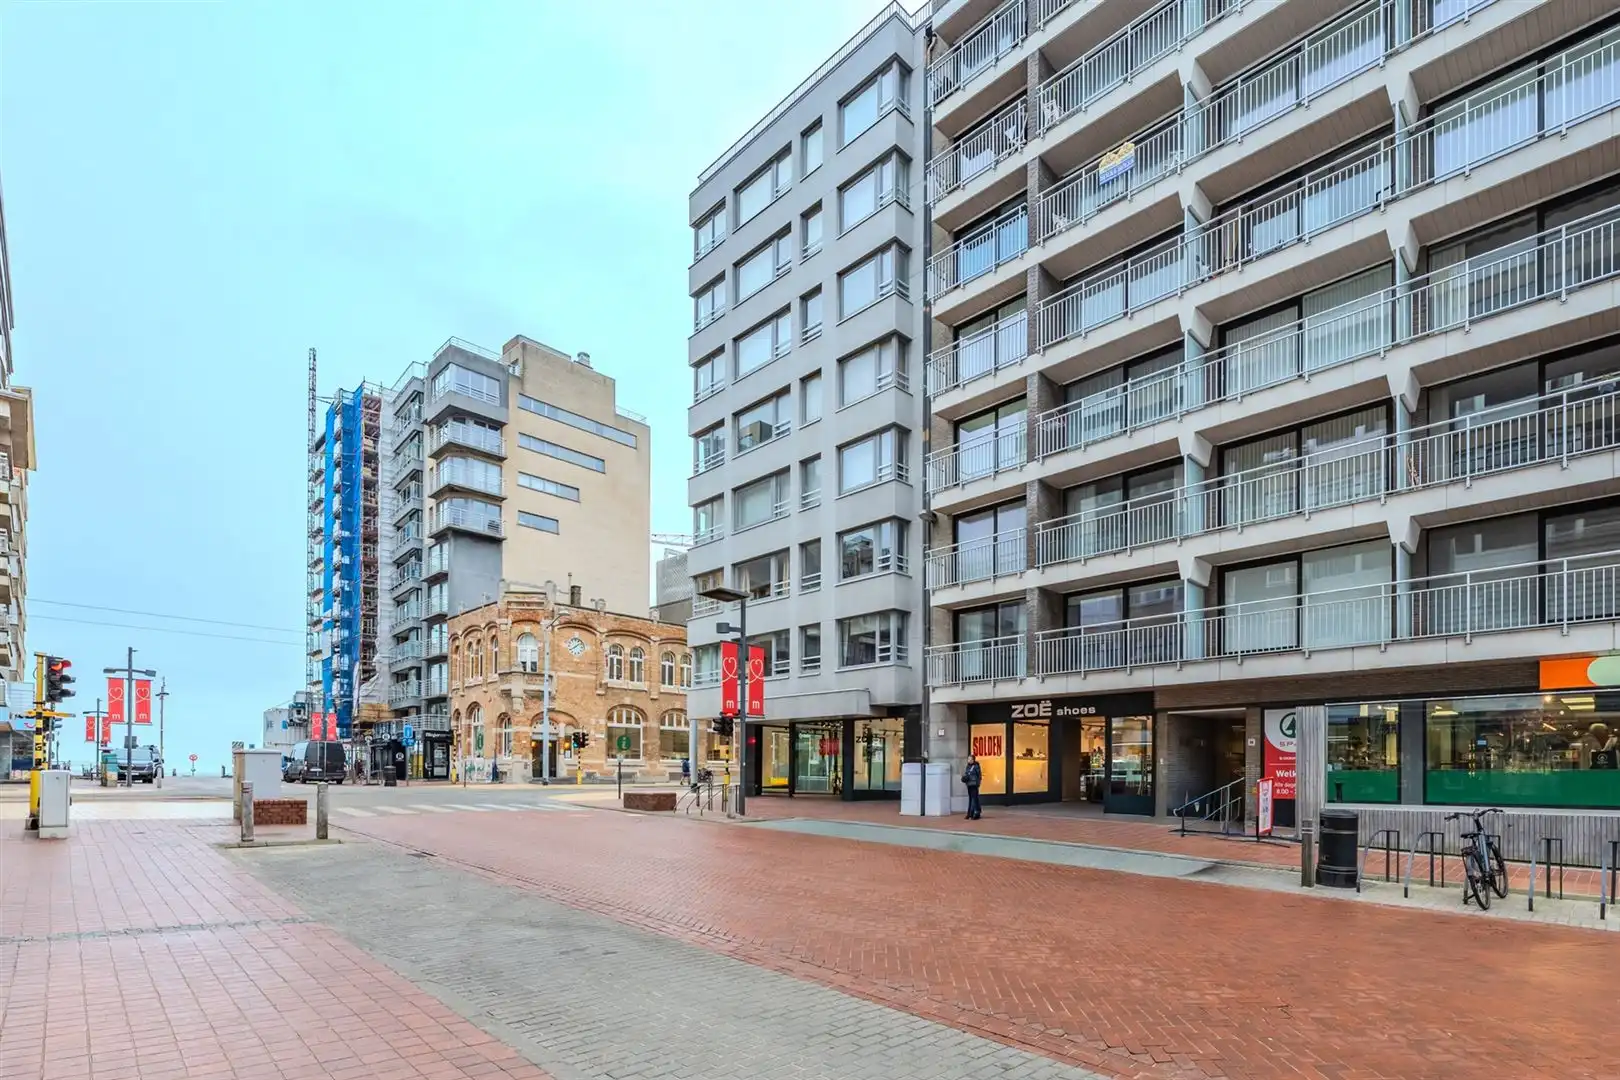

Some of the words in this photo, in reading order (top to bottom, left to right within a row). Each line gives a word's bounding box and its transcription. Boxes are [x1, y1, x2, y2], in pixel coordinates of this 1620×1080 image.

[1010, 700, 1052, 718] ZOË
[1056, 706, 1096, 716] shoes
[973, 735, 1002, 757] SOLDEN
